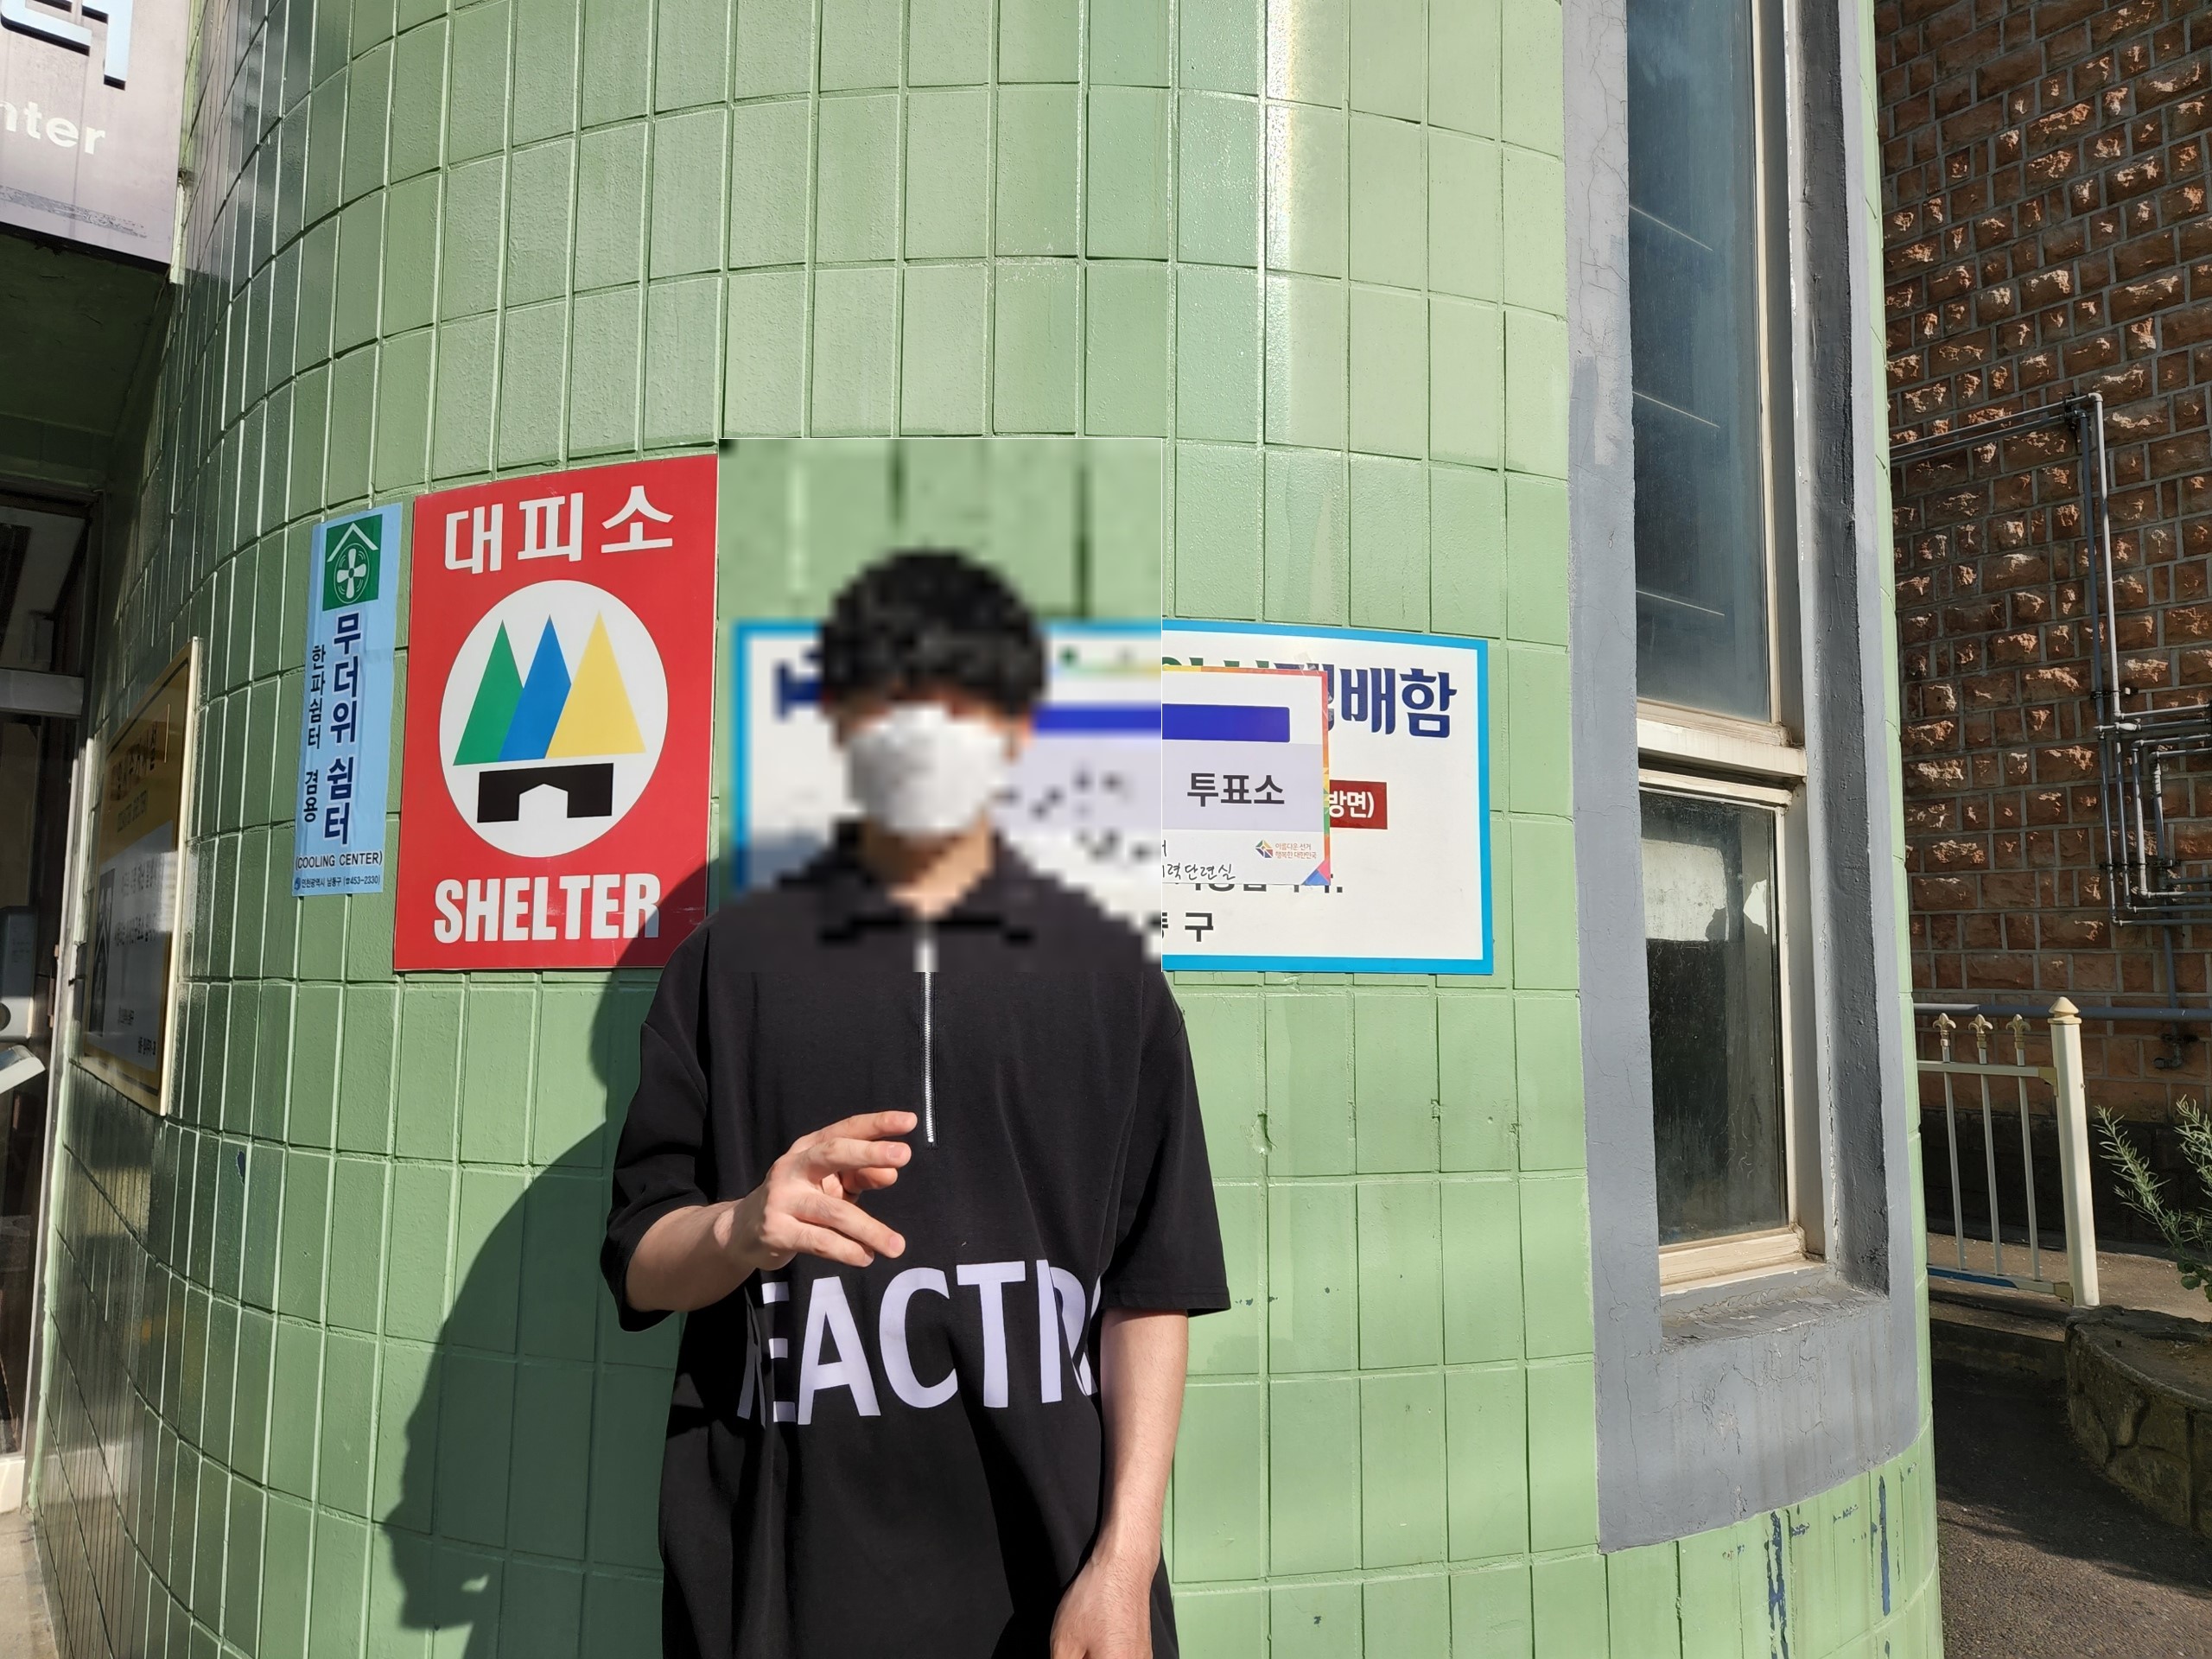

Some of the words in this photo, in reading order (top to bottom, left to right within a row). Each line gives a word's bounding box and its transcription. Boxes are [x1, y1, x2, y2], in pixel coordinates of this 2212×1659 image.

[443, 485, 674, 575] 대피소
[307, 644, 327, 750] 한파쉼터
[329, 611, 362, 744] 무더위
[303, 769, 319, 823] 겸용
[323, 756, 354, 845] 쉼터
[1186, 772, 1286, 807] 투표소
[296, 855, 335, 871] (COOLING
[340, 850, 383, 867] CENTER)
[1275, 842, 1299, 851] 아름다운
[1300, 842, 1312, 851] 선거
[1294, 851, 1317, 860] 대한민국
[327, 876, 342, 888] 남동구
[434, 873, 662, 944] SHELTER
